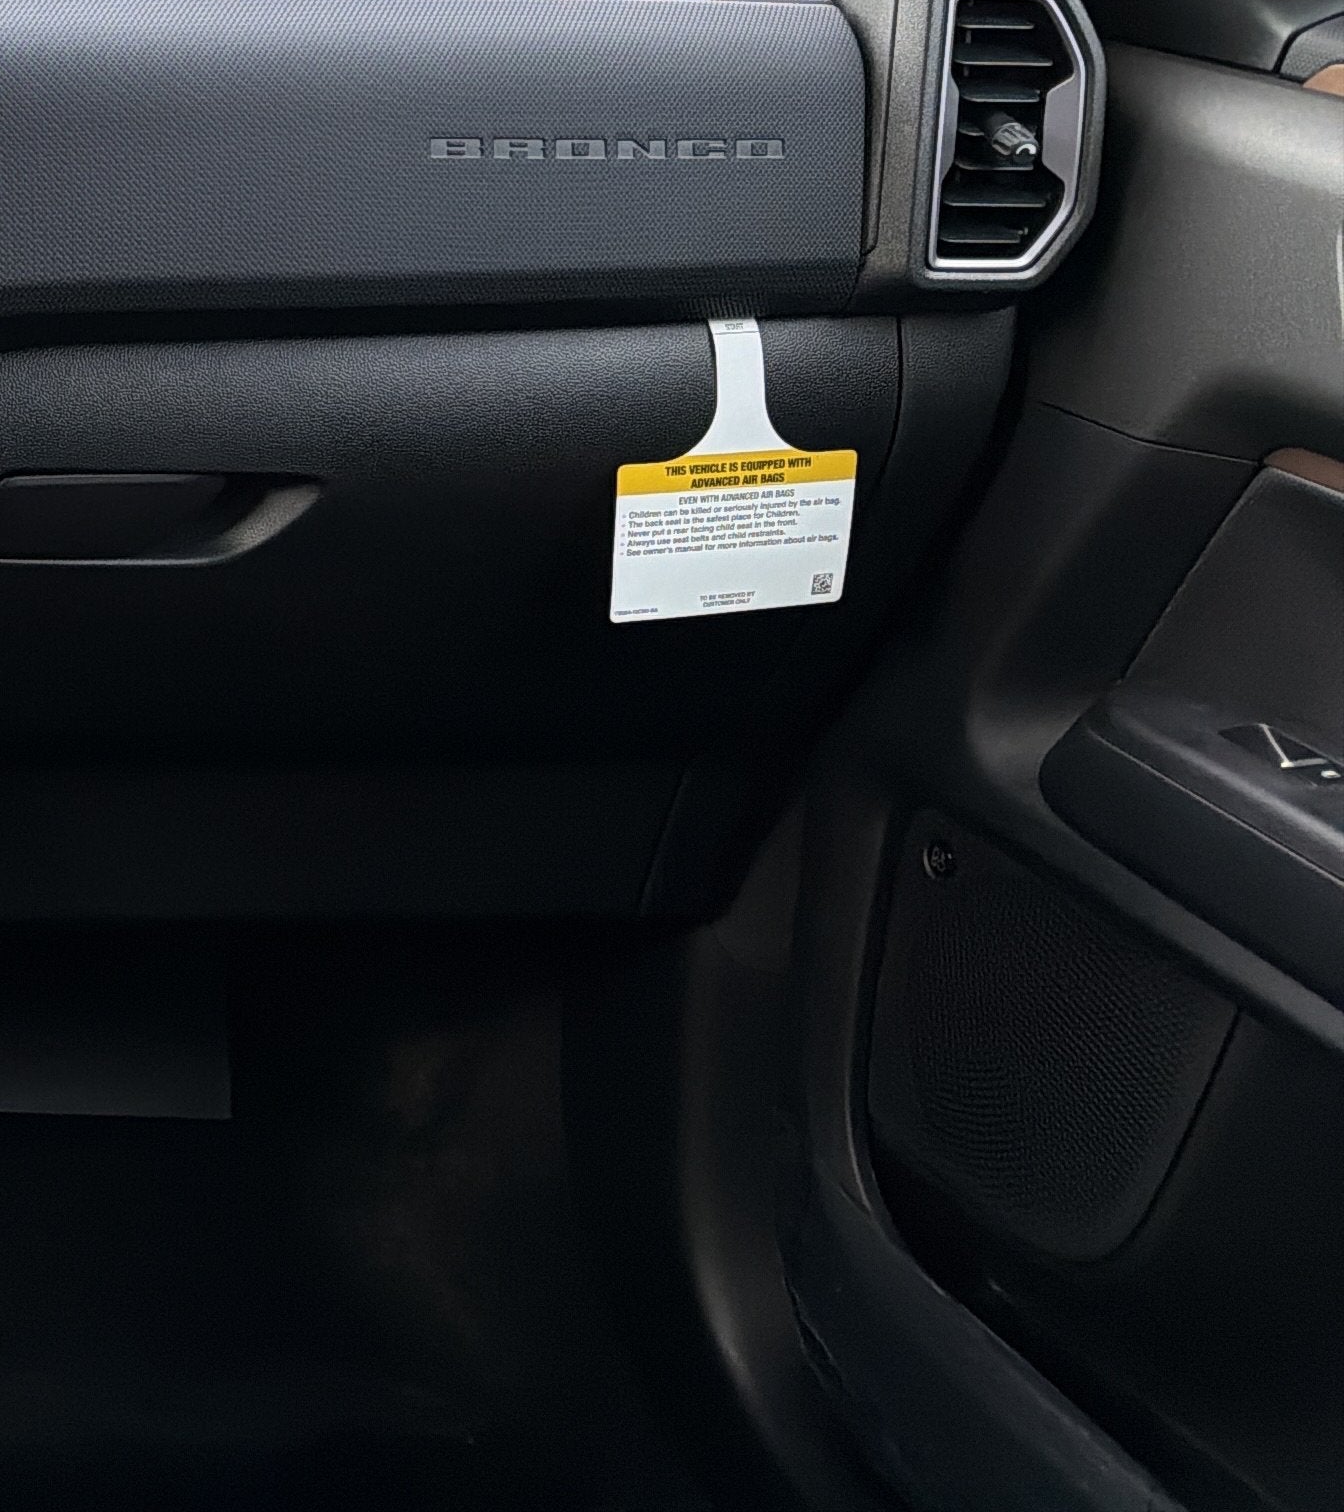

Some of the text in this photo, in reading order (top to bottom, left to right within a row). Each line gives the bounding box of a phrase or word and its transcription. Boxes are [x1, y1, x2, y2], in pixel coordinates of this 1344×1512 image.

[428, 136, 788, 162] BRONCO
[665, 457, 812, 477] THIS VEHICLE IS EQUIPPED WITH
[690, 472, 785, 489] ADVANCED AIR BAGS
[678, 488, 795, 506] EVEN WITH ADVANCED AIR BAGS
[628, 510, 662, 520] Children
[663, 510, 678, 518] can
[679, 508, 690, 516] be
[691, 506, 712, 515] killed
[723, 503, 759, 515] seriously
[760, 501, 787, 511] injured
[788, 500, 798, 509] by
[799, 499, 812, 507] the
